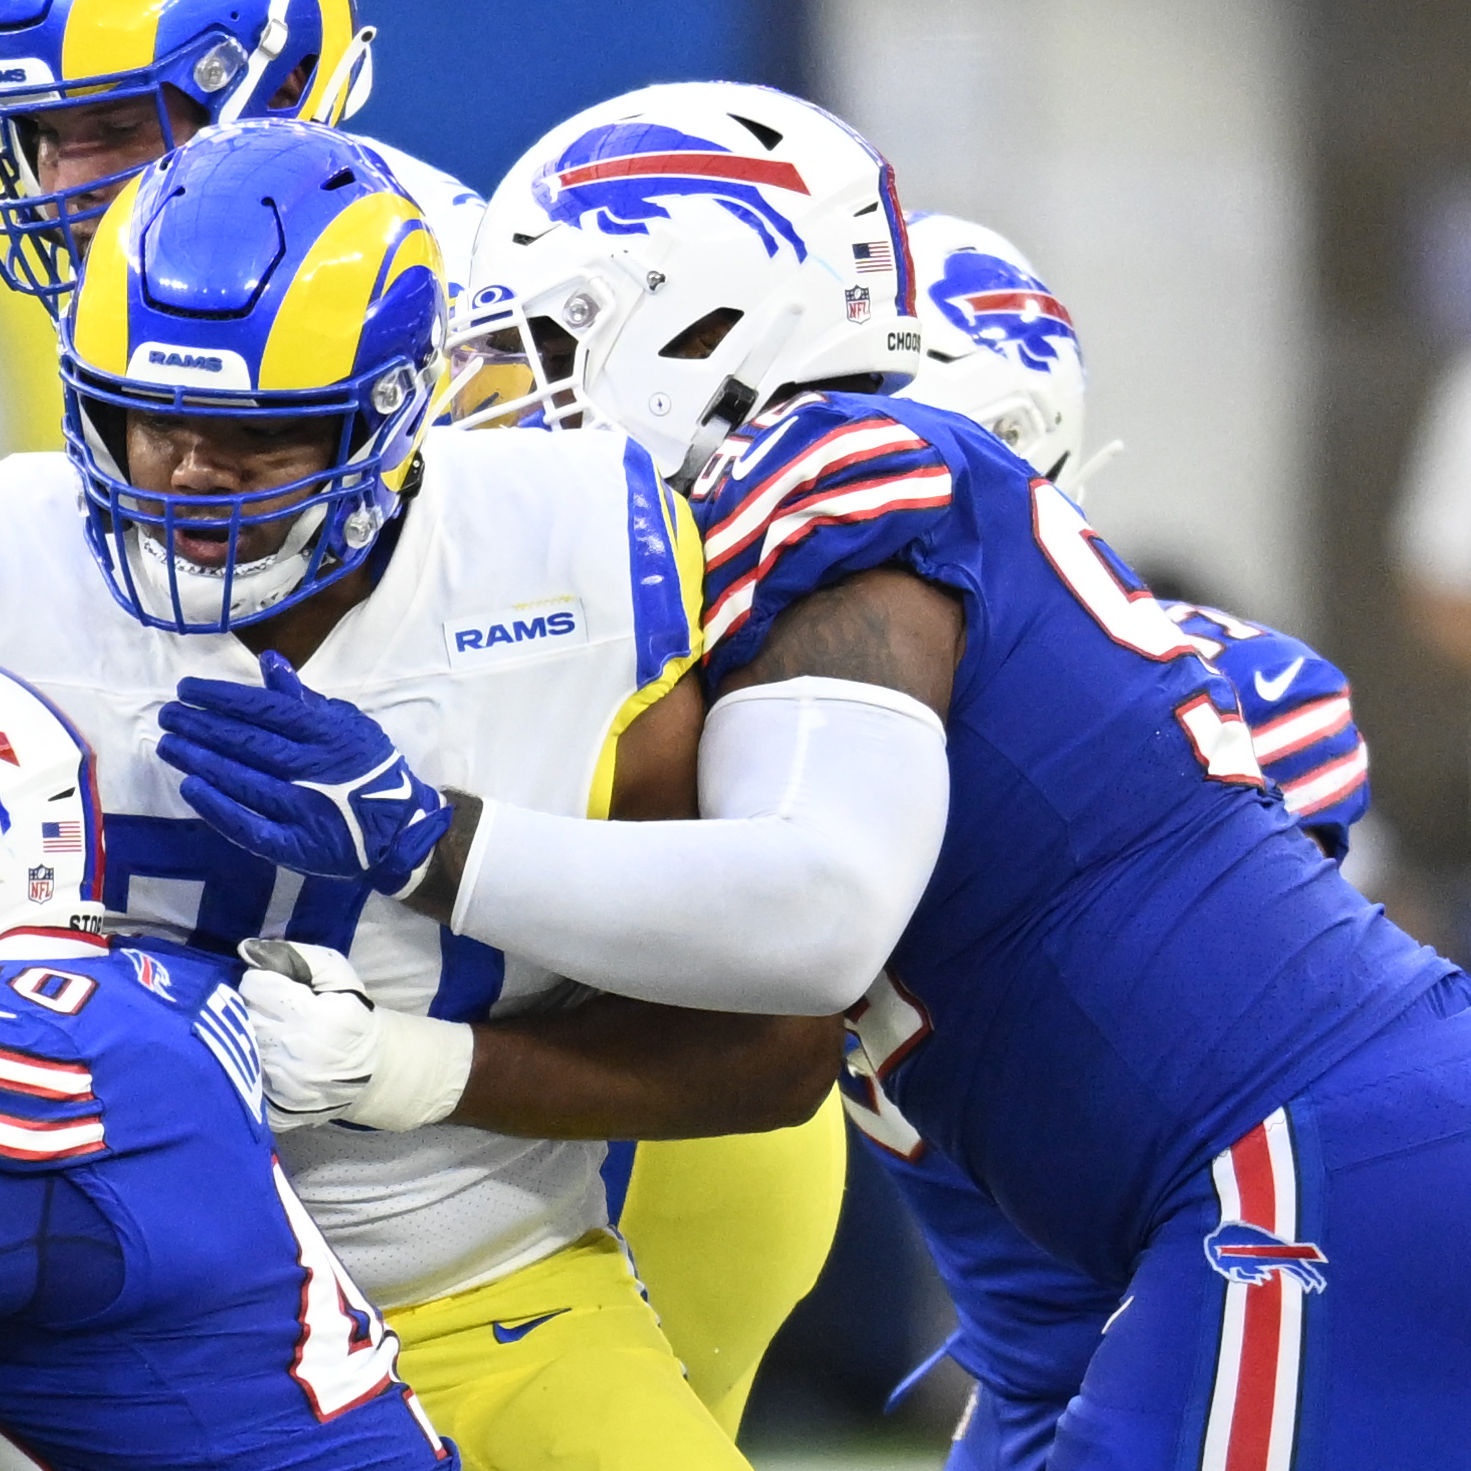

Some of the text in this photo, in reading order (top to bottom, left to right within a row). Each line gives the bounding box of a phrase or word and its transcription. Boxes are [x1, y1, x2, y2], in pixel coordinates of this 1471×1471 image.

[148, 350, 223, 373] RAMS
[455, 612, 576, 652] RAMS
[31, 881, 52, 900] NFL
